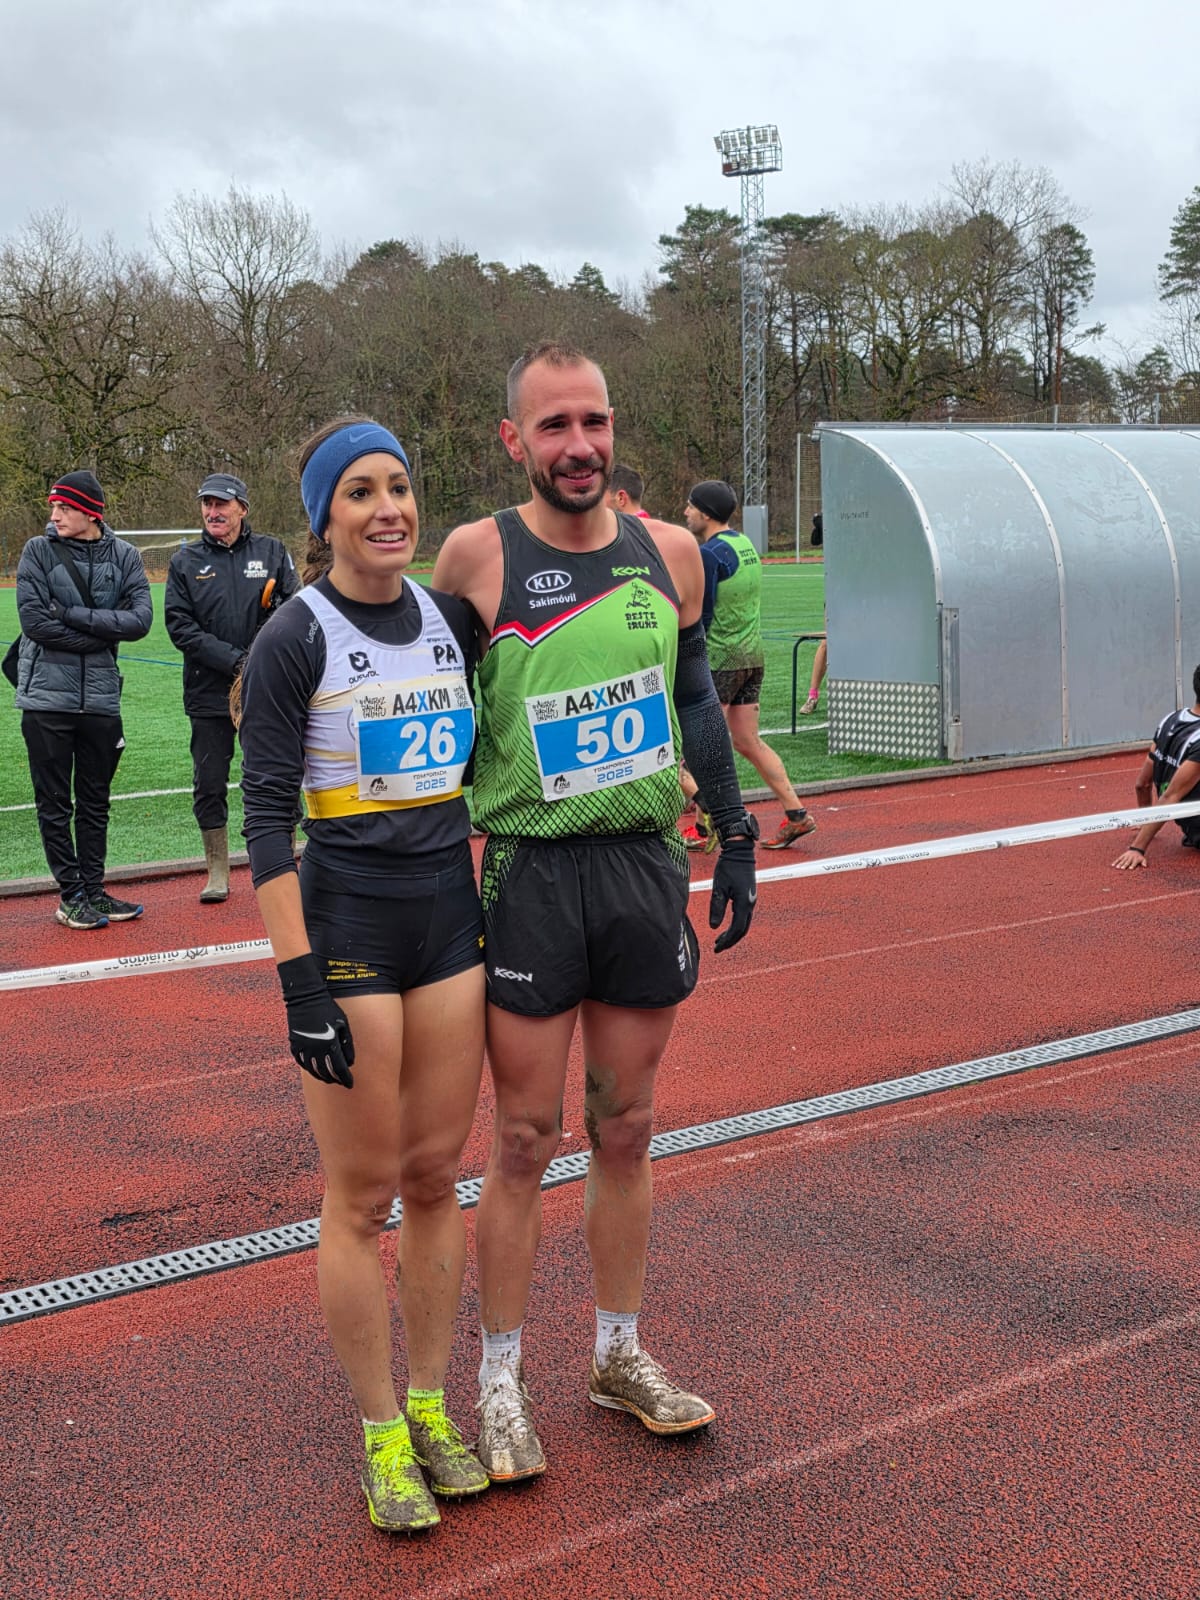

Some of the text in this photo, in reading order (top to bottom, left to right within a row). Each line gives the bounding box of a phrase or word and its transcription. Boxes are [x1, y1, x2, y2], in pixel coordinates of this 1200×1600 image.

[533, 574, 566, 590] KIA
[529, 592, 577, 609] Sakimóvil
[433, 643, 458, 665] PA
[392, 687, 451, 716] A4XKM
[565, 679, 637, 717] A4XKM
[399, 716, 457, 770] 26
[575, 707, 645, 764] 50
[415, 777, 447, 791] 2025
[596, 765, 633, 784] 2025
